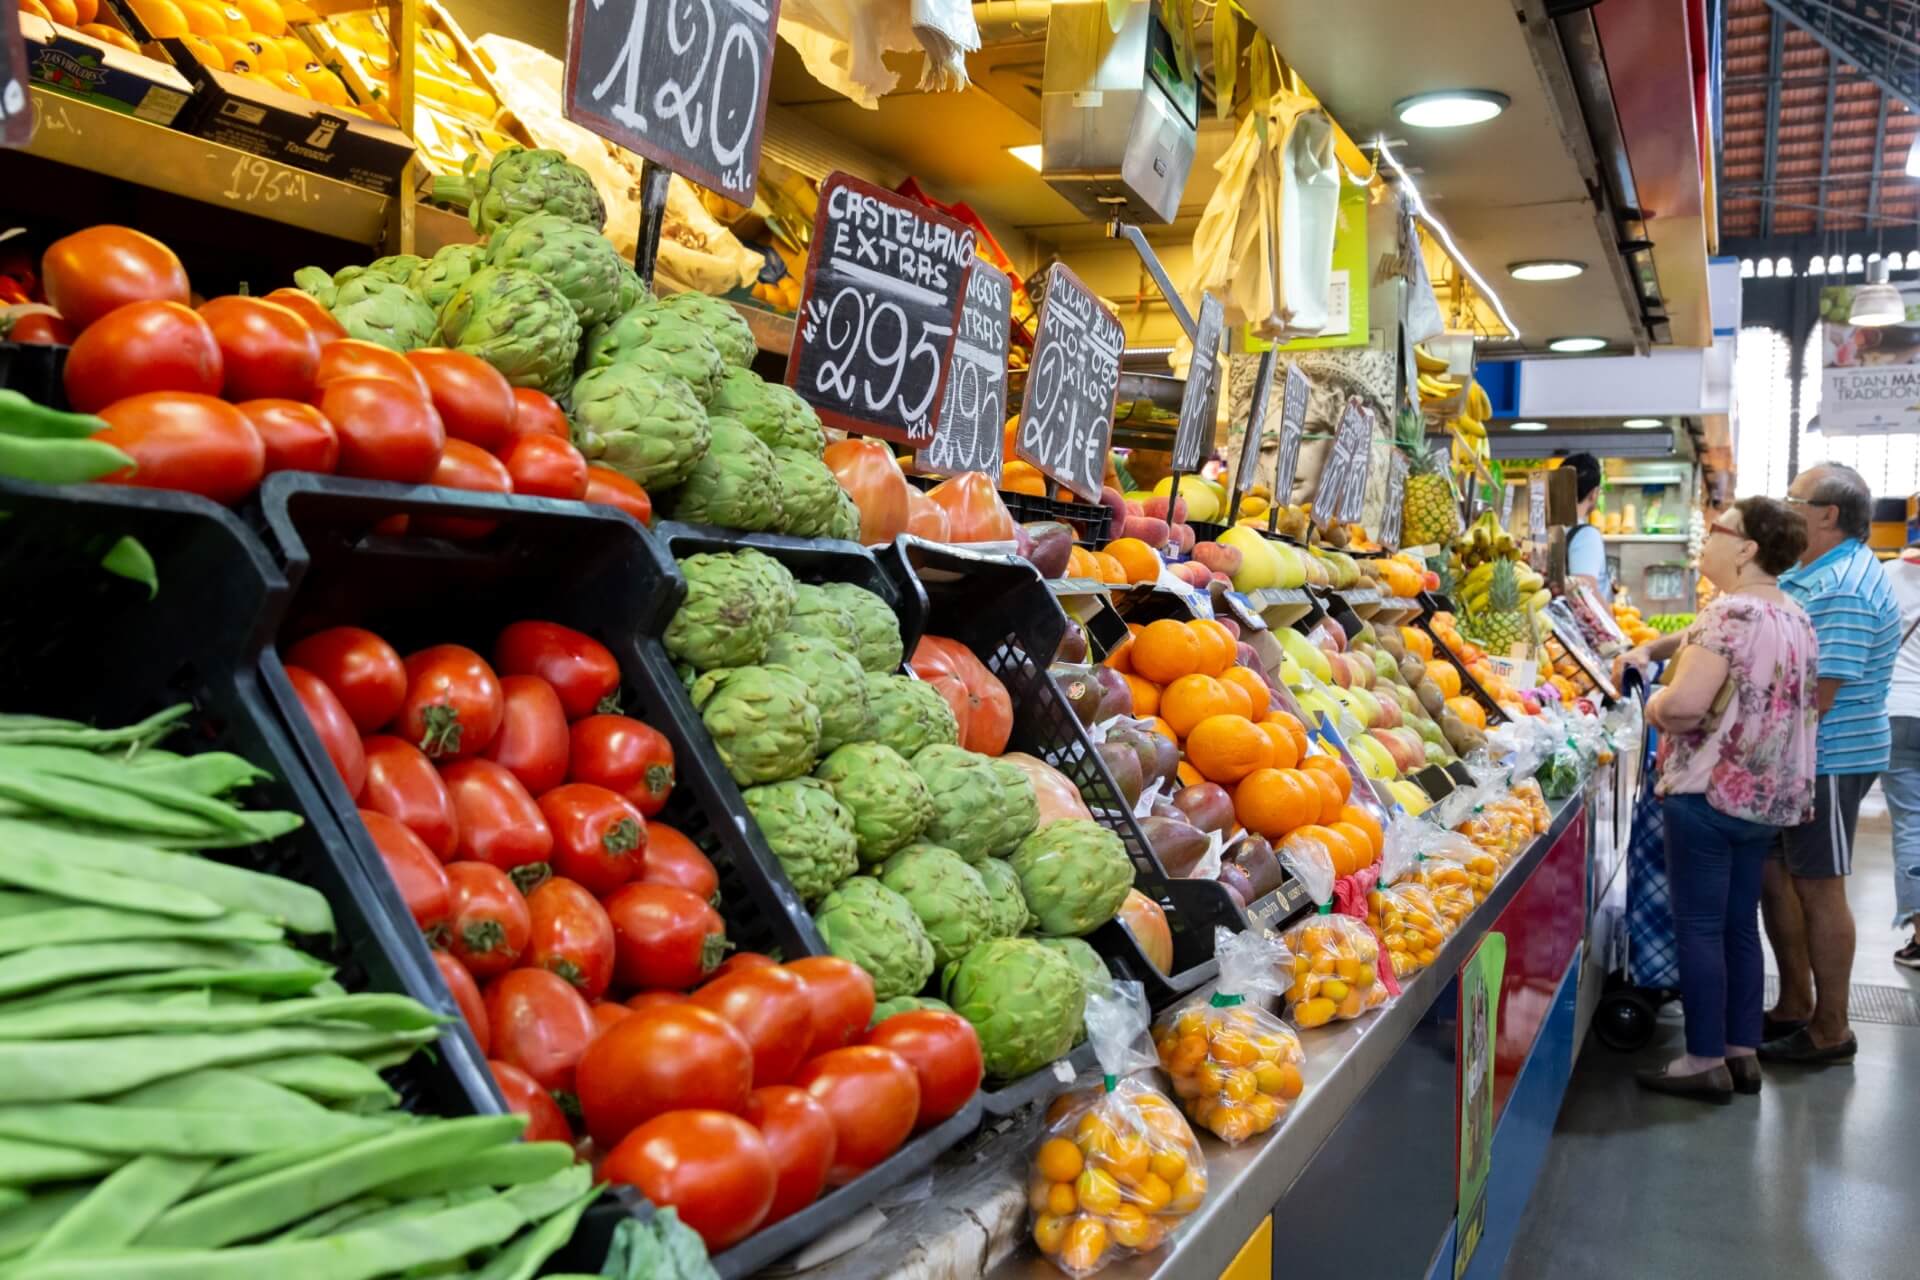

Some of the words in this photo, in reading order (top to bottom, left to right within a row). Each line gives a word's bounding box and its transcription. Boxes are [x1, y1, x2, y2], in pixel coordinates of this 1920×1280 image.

[834, 224, 948, 289] EXTRAS
[1051, 270, 1092, 322] MUCHO
[1045, 311, 1078, 357] KILO
[1832, 376, 1848, 389] TE
[1852, 375, 1888, 388] DAN
